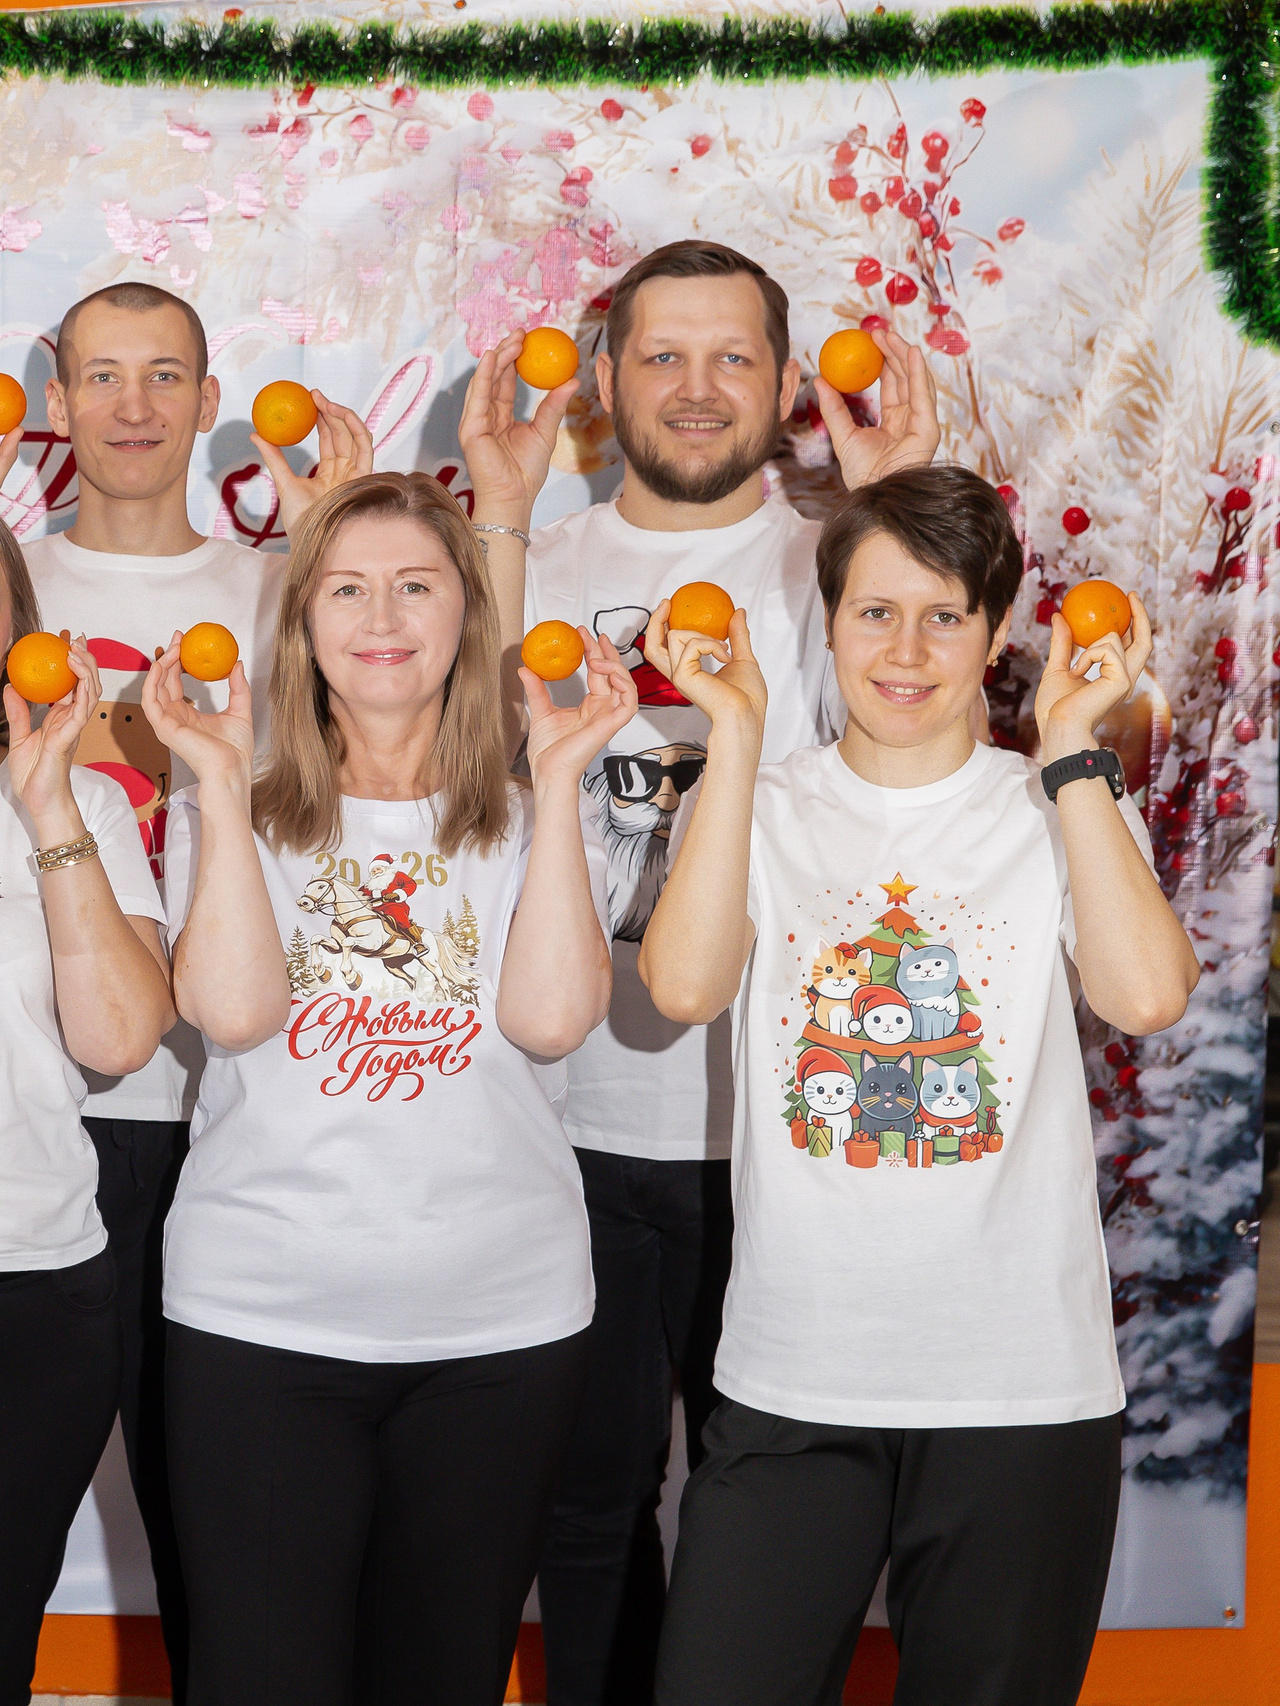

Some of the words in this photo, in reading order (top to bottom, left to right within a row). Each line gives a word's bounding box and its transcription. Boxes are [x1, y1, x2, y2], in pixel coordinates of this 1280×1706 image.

[282, 992, 340, 1060] С
[321, 994, 476, 1052] Новым
[320, 1023, 482, 1102] Годом!
